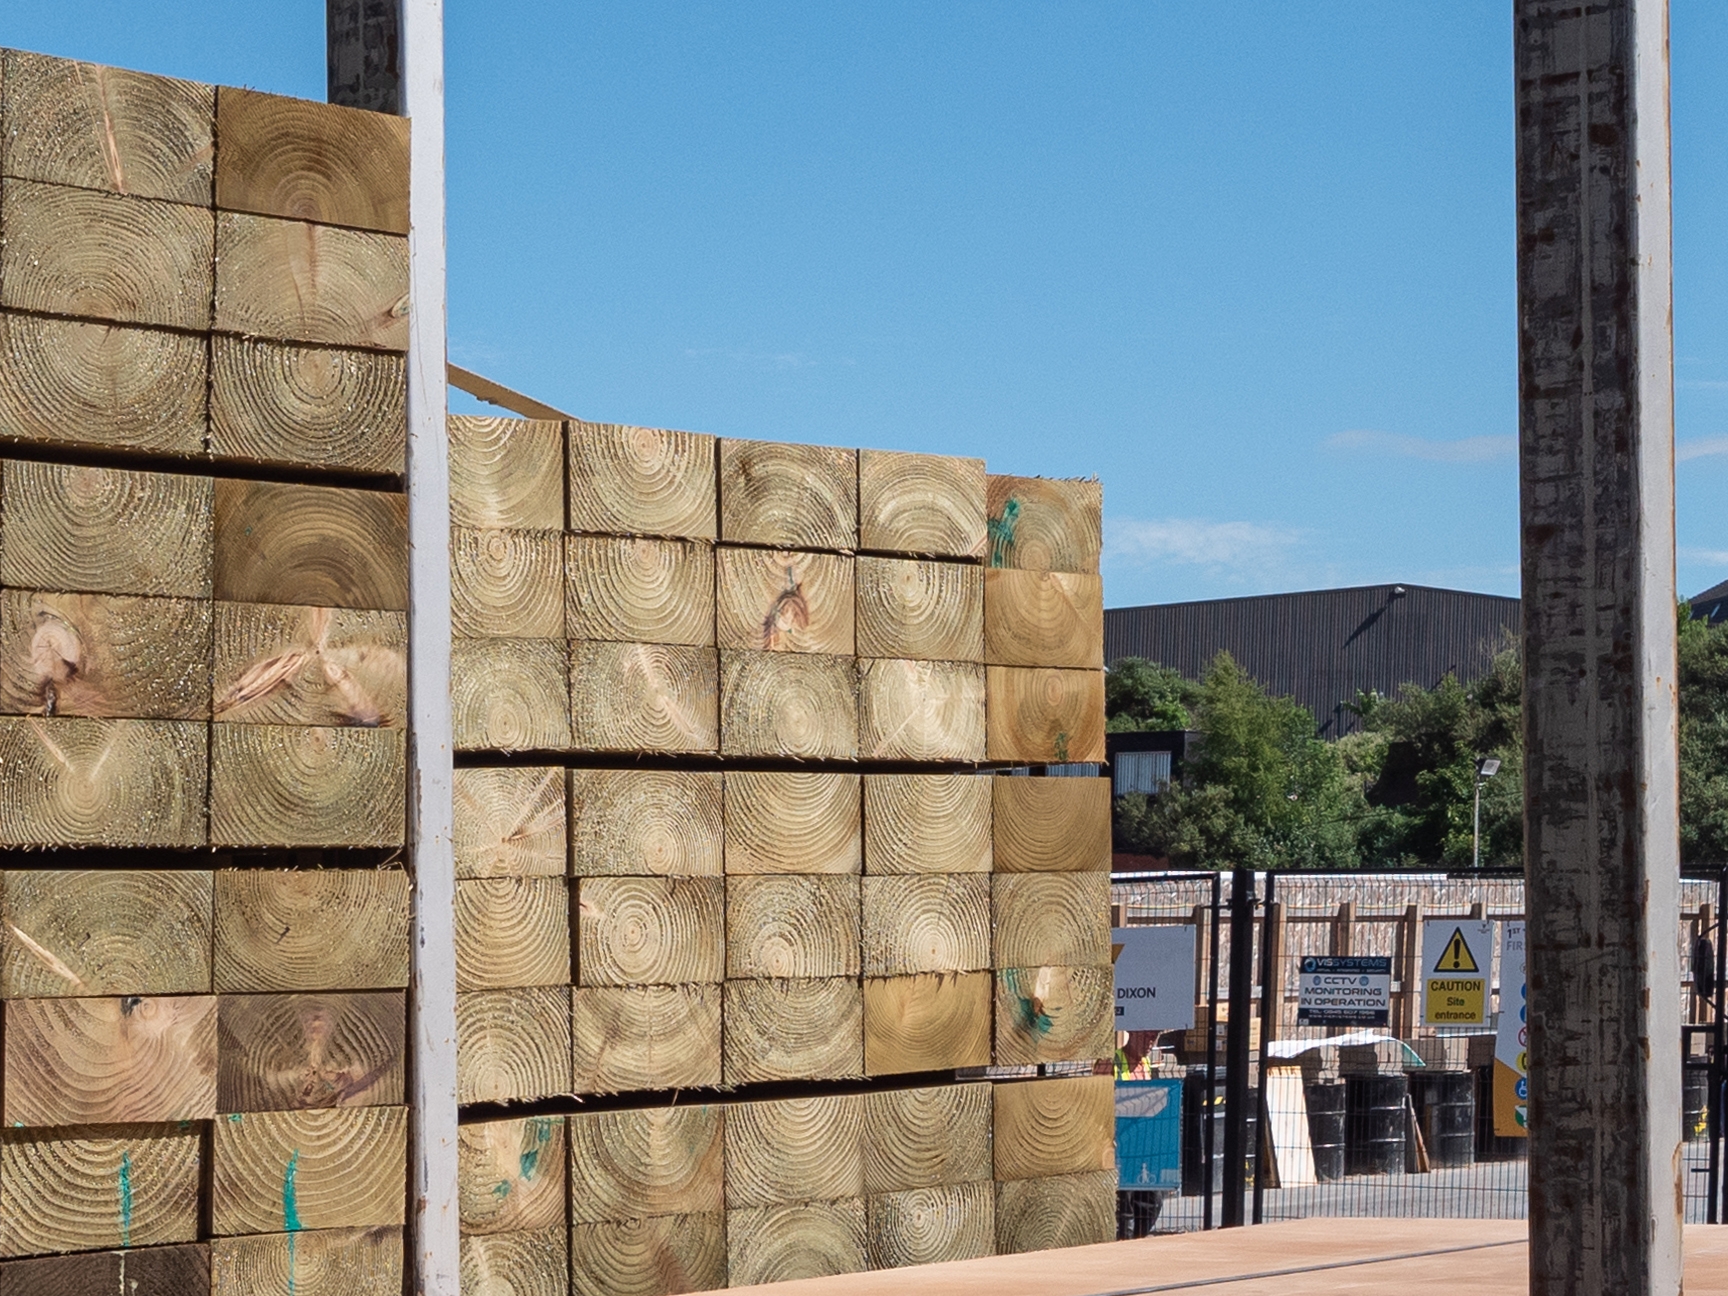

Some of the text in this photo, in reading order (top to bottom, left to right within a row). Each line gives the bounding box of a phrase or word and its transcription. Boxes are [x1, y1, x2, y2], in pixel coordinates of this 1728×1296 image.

[1506, 940, 1523, 951] FIR
[1316, 958, 1387, 967] VISSYSTEMS
[1324, 976, 1357, 985] CCTV
[1430, 980, 1481, 992] CAUTION
[1117, 987, 1156, 999] DIXON
[1305, 987, 1382, 996] MONITORING
[1301, 997, 1386, 1007] IN OPERATION
[1446, 996, 1465, 1007] Site
[1434, 1009, 1476, 1021] entrance
